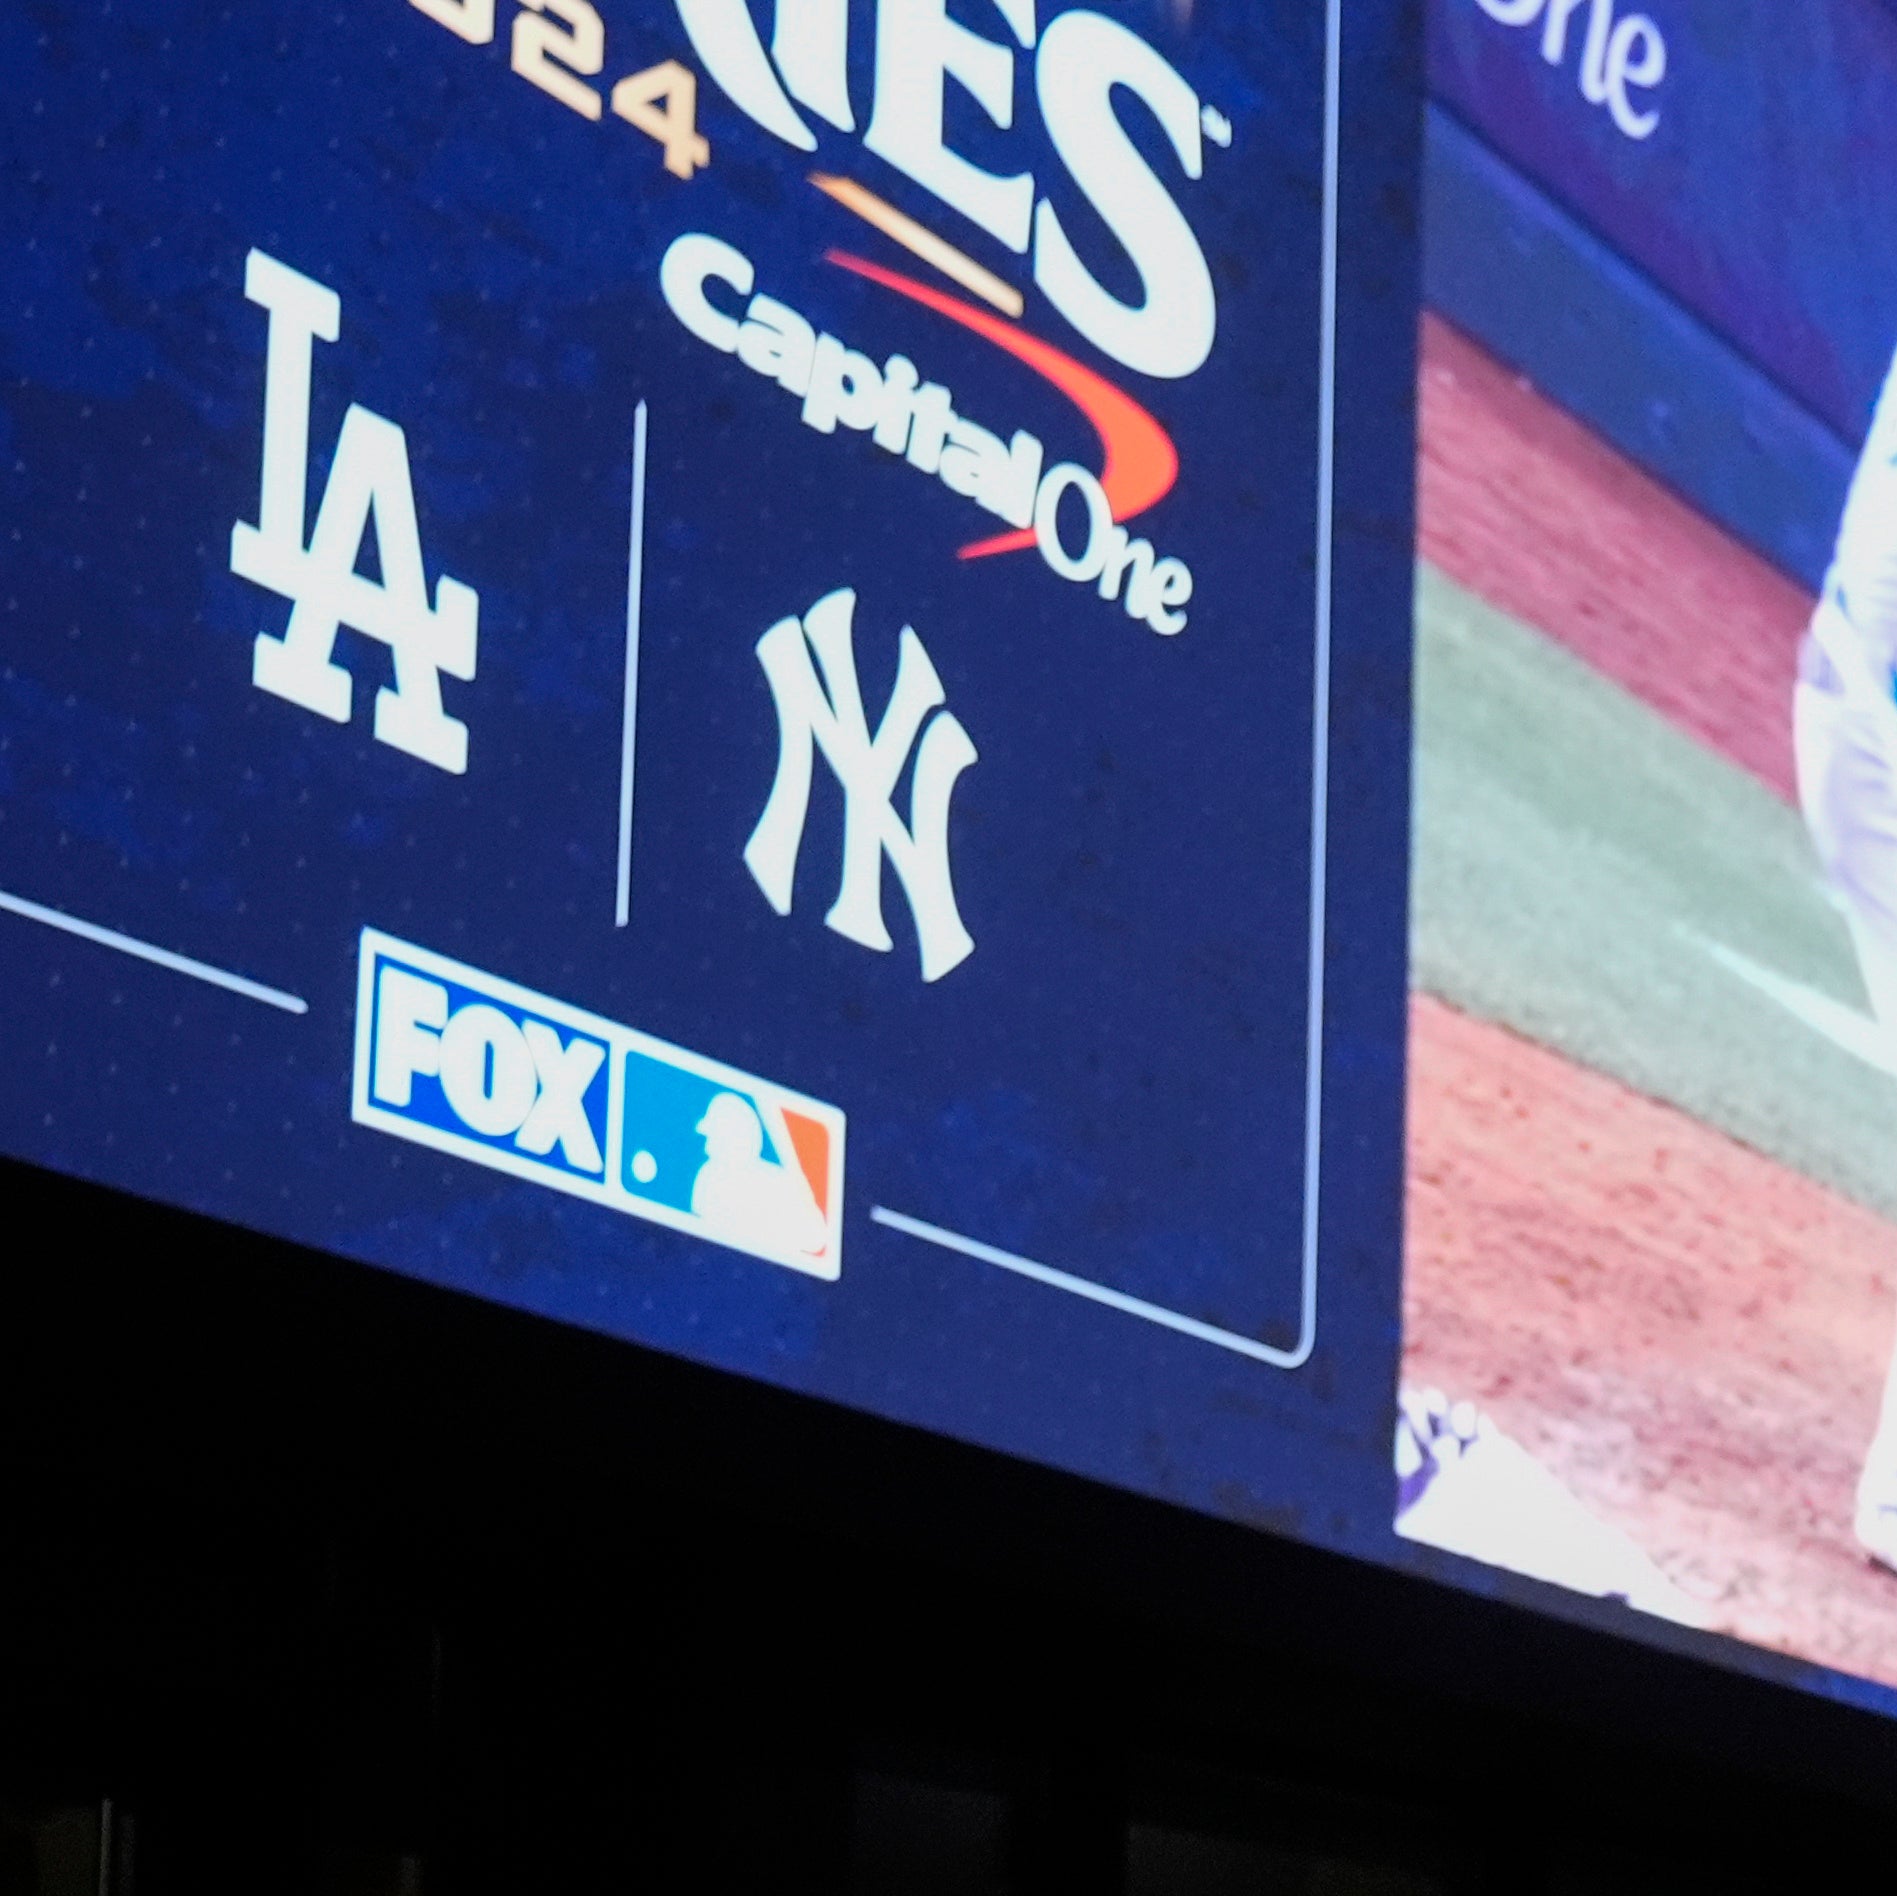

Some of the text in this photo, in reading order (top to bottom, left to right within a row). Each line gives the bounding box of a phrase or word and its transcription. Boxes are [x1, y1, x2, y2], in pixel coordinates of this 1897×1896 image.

[231, 247, 478, 775] LA
[742, 587, 978, 982] NY
[372, 962, 607, 1182] FOX
